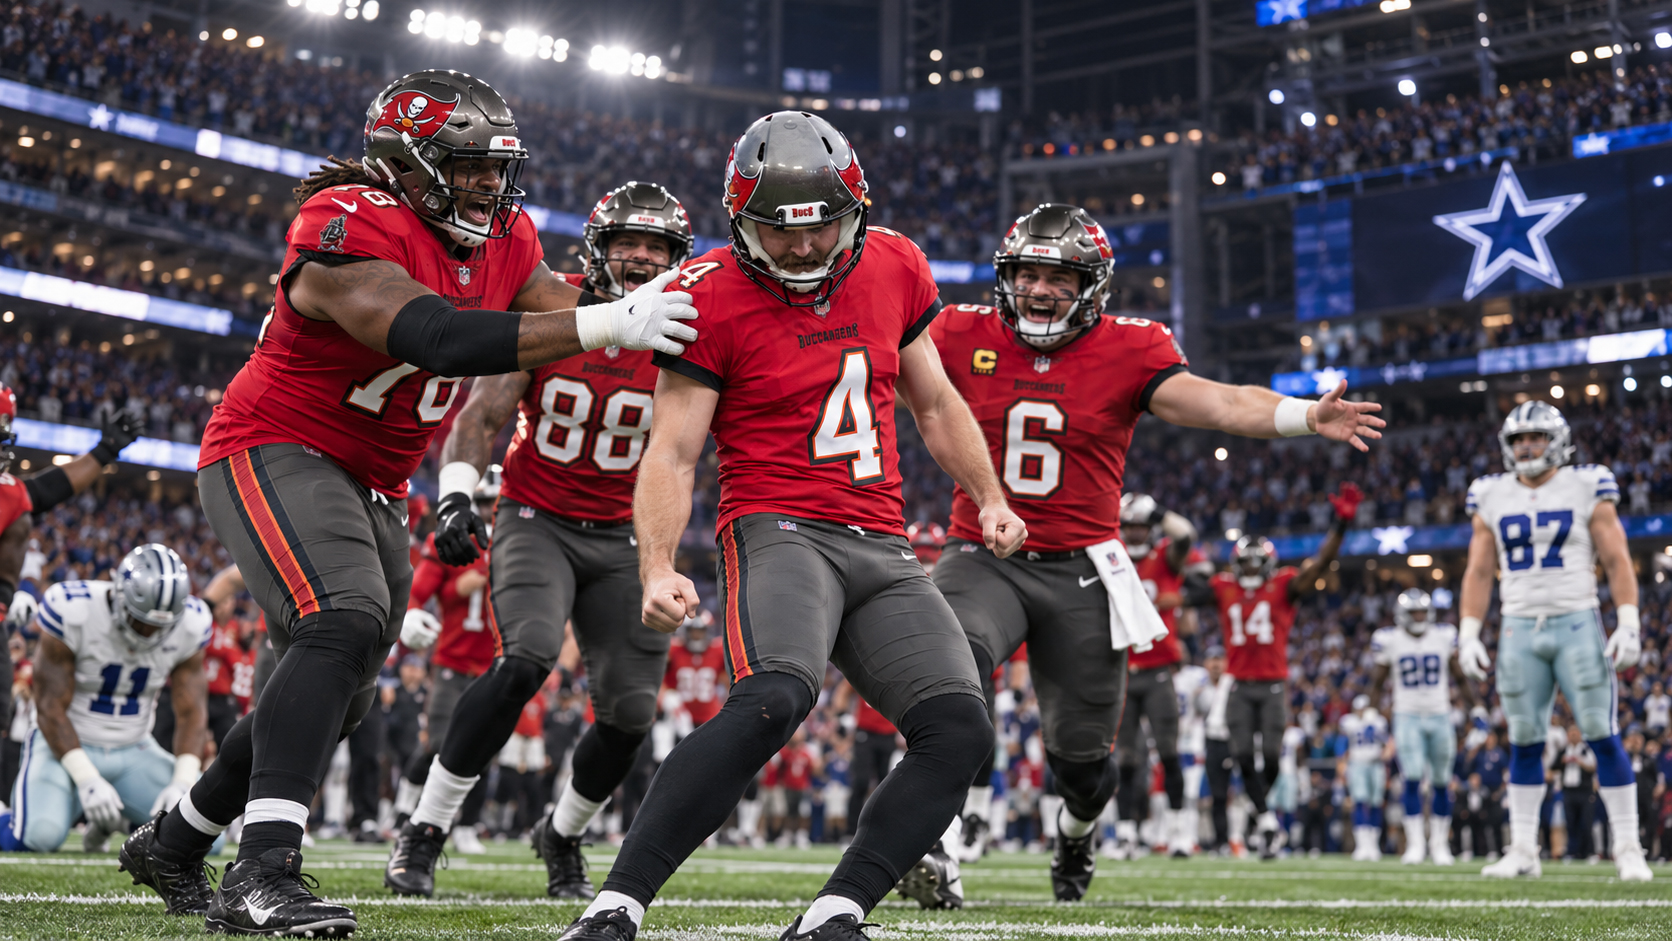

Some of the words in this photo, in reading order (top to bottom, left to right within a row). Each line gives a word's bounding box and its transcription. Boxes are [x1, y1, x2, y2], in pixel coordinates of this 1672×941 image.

[973, 349, 998, 370] C
[533, 372, 654, 475] 88
[807, 346, 886, 487] 4
[1001, 397, 1069, 501] 6
[1499, 510, 1574, 571] 87
[1228, 601, 1275, 646] 14
[89, 663, 150, 716] 11
[1400, 654, 1440, 686] 28
